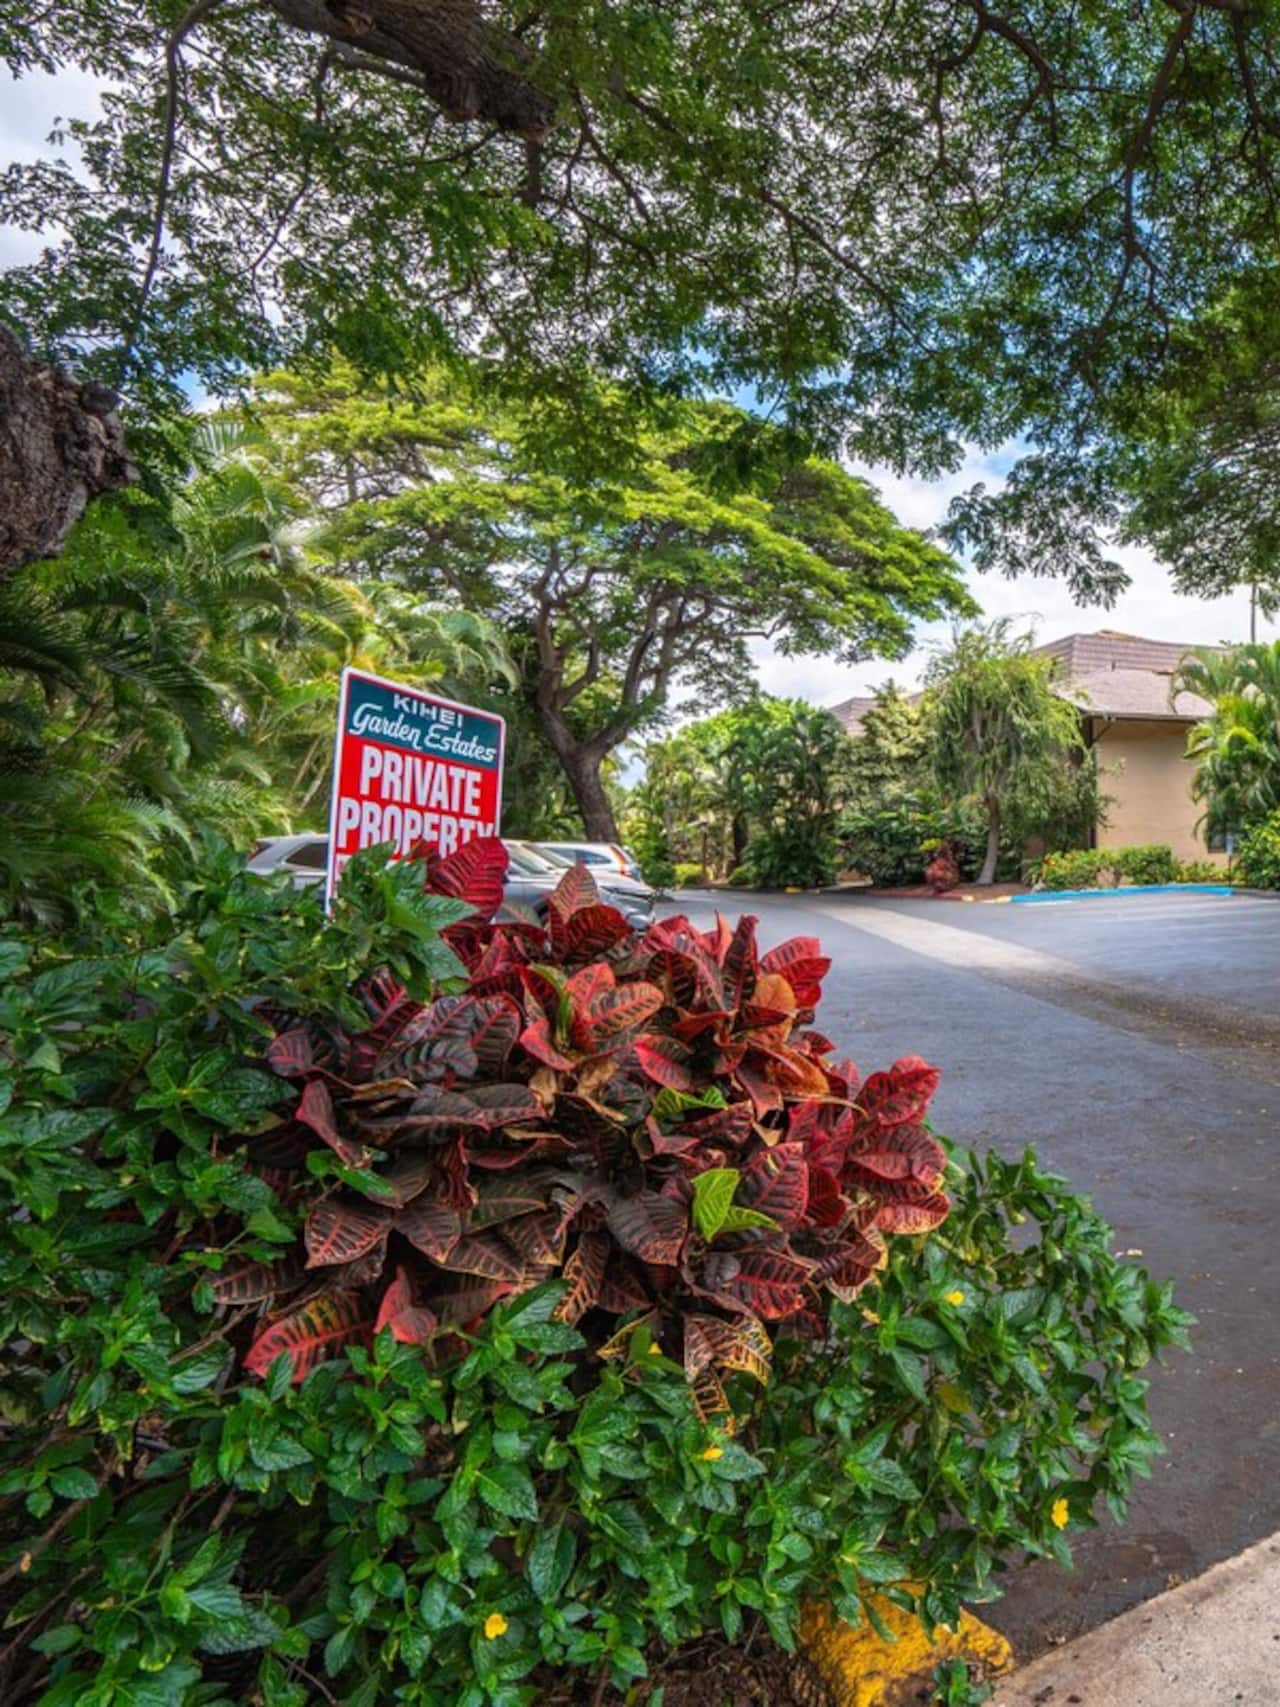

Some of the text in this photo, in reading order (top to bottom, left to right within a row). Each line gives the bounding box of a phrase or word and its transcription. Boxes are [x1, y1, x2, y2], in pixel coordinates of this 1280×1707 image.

[349, 703, 497, 763] Garden Estates
[393, 694, 463, 727] KIHEI
[359, 745, 482, 817] PRIVATE
